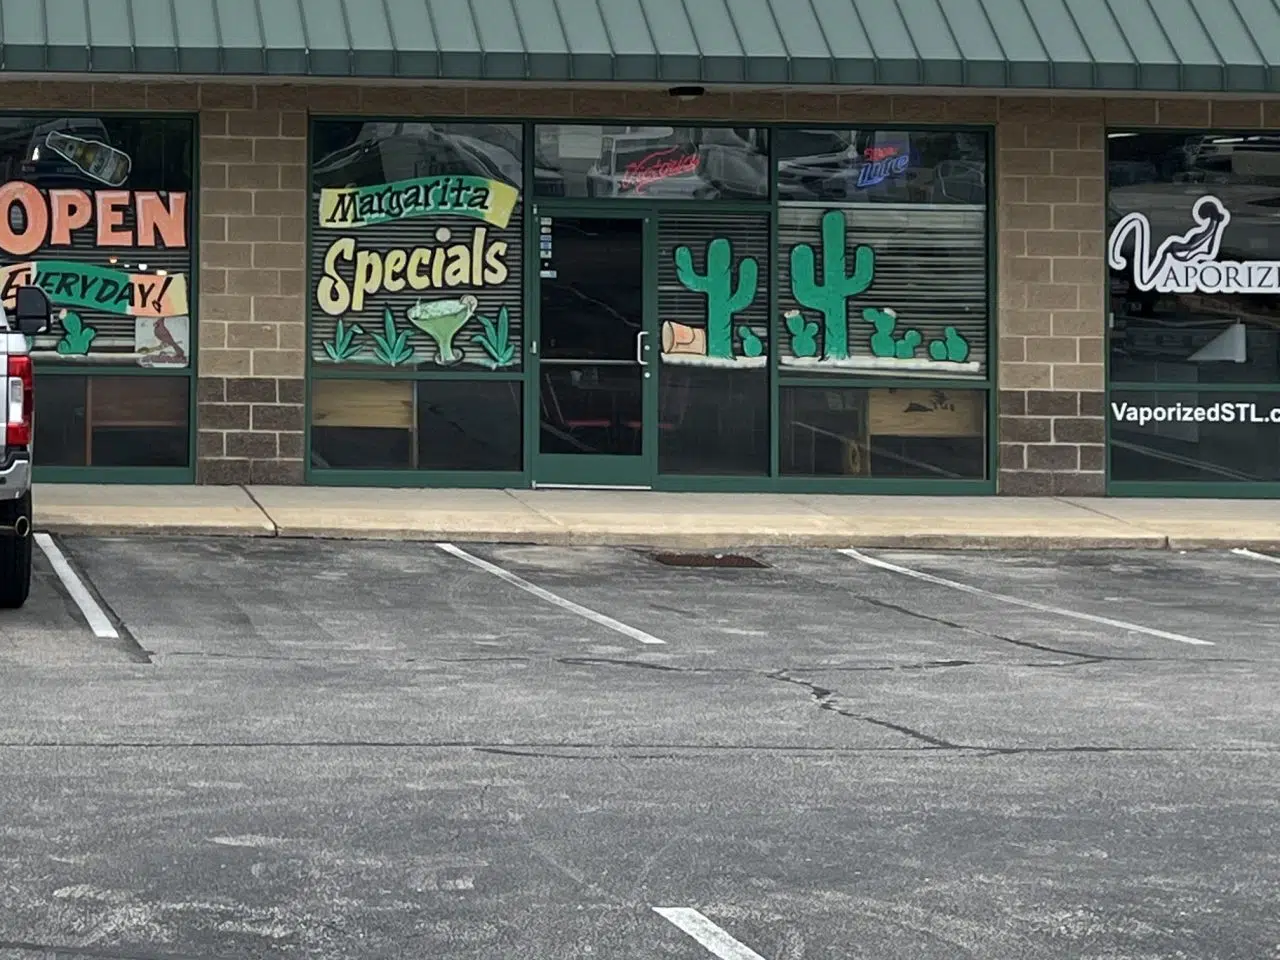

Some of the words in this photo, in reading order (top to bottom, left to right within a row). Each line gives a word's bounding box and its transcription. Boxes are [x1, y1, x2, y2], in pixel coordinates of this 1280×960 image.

[325, 178, 490, 223] Margarita
[1109, 196, 1280, 292] VAPORIZ
[317, 227, 509, 315] Specials
